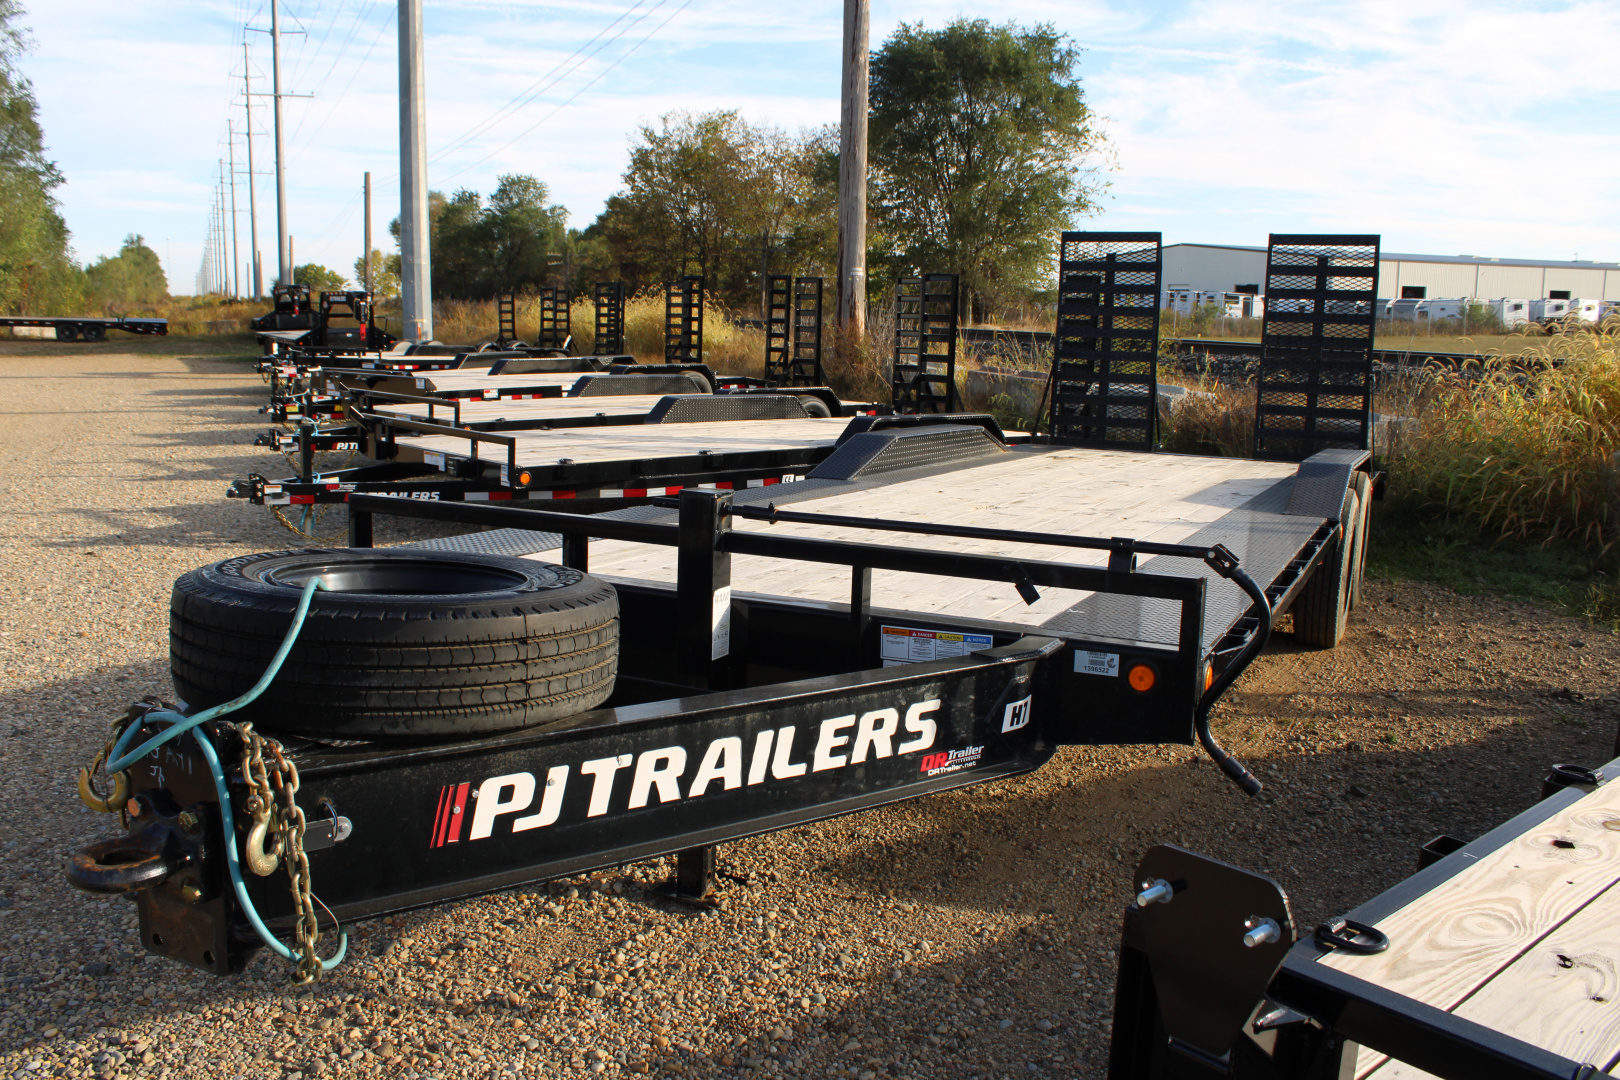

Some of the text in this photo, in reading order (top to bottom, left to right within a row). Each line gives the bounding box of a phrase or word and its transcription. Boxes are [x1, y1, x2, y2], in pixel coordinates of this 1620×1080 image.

[714, 590, 729, 605] RAM
[469, 698, 941, 841] PJ TRAILERS
[920, 752, 949, 772] DR
[948, 745, 984, 761] Trailer
[927, 760, 977, 777] DRTrailer.net
